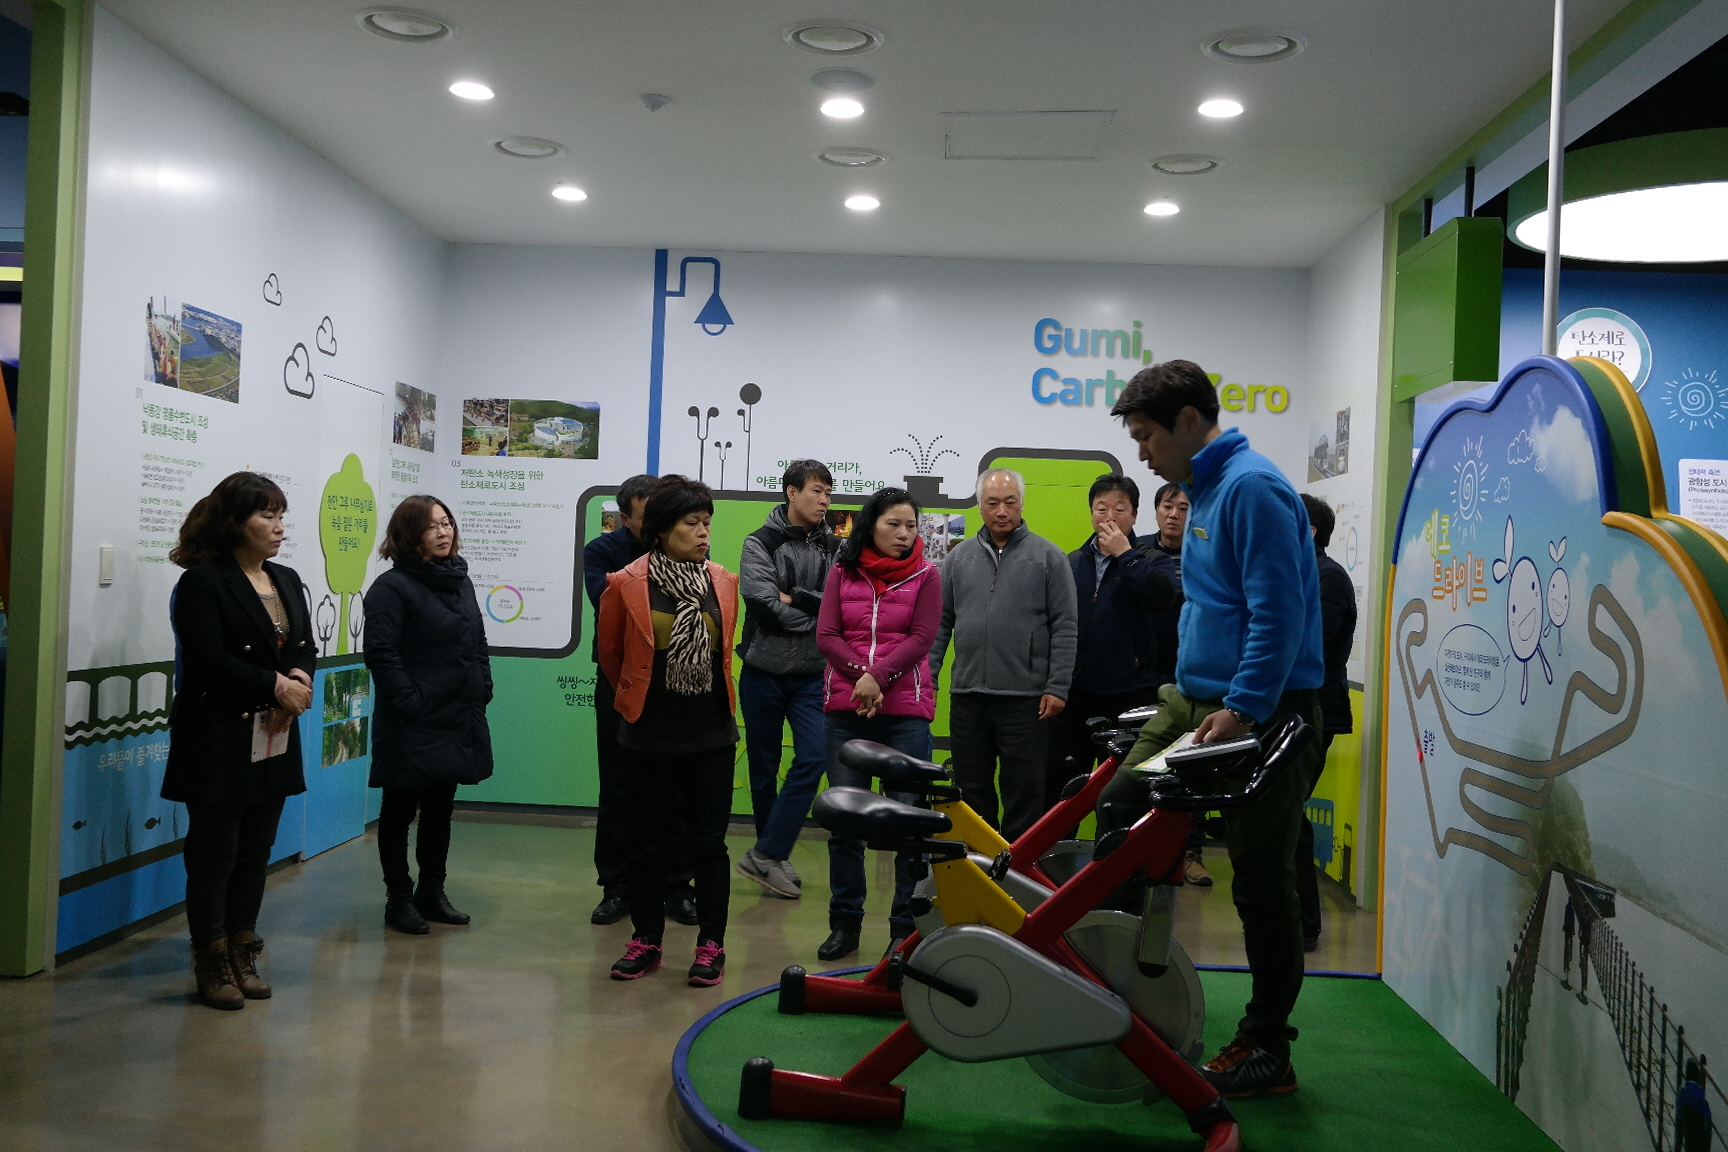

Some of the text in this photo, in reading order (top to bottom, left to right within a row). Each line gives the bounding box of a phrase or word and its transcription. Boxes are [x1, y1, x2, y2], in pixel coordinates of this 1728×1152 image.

[1033, 317, 1152, 364] Gumi,
[1570, 330, 1627, 346] 탄소제로
[1031, 367, 1129, 406] Carb
[142, 402, 161, 419] 낙동강
[197, 415, 209, 429] 조성
[141, 420, 149, 434] 및
[451, 460, 461, 468] 03
[827, 462, 862, 475] 거리가,
[460, 468, 544, 480] 저탄소 녹색성장을 위한
[460, 480, 525, 491] 탄소제로도시 조성
[1688, 477, 1728, 487] 광합성 도시
[1425, 508, 1451, 560] 에코
[1431, 550, 1488, 612] 드라이브
